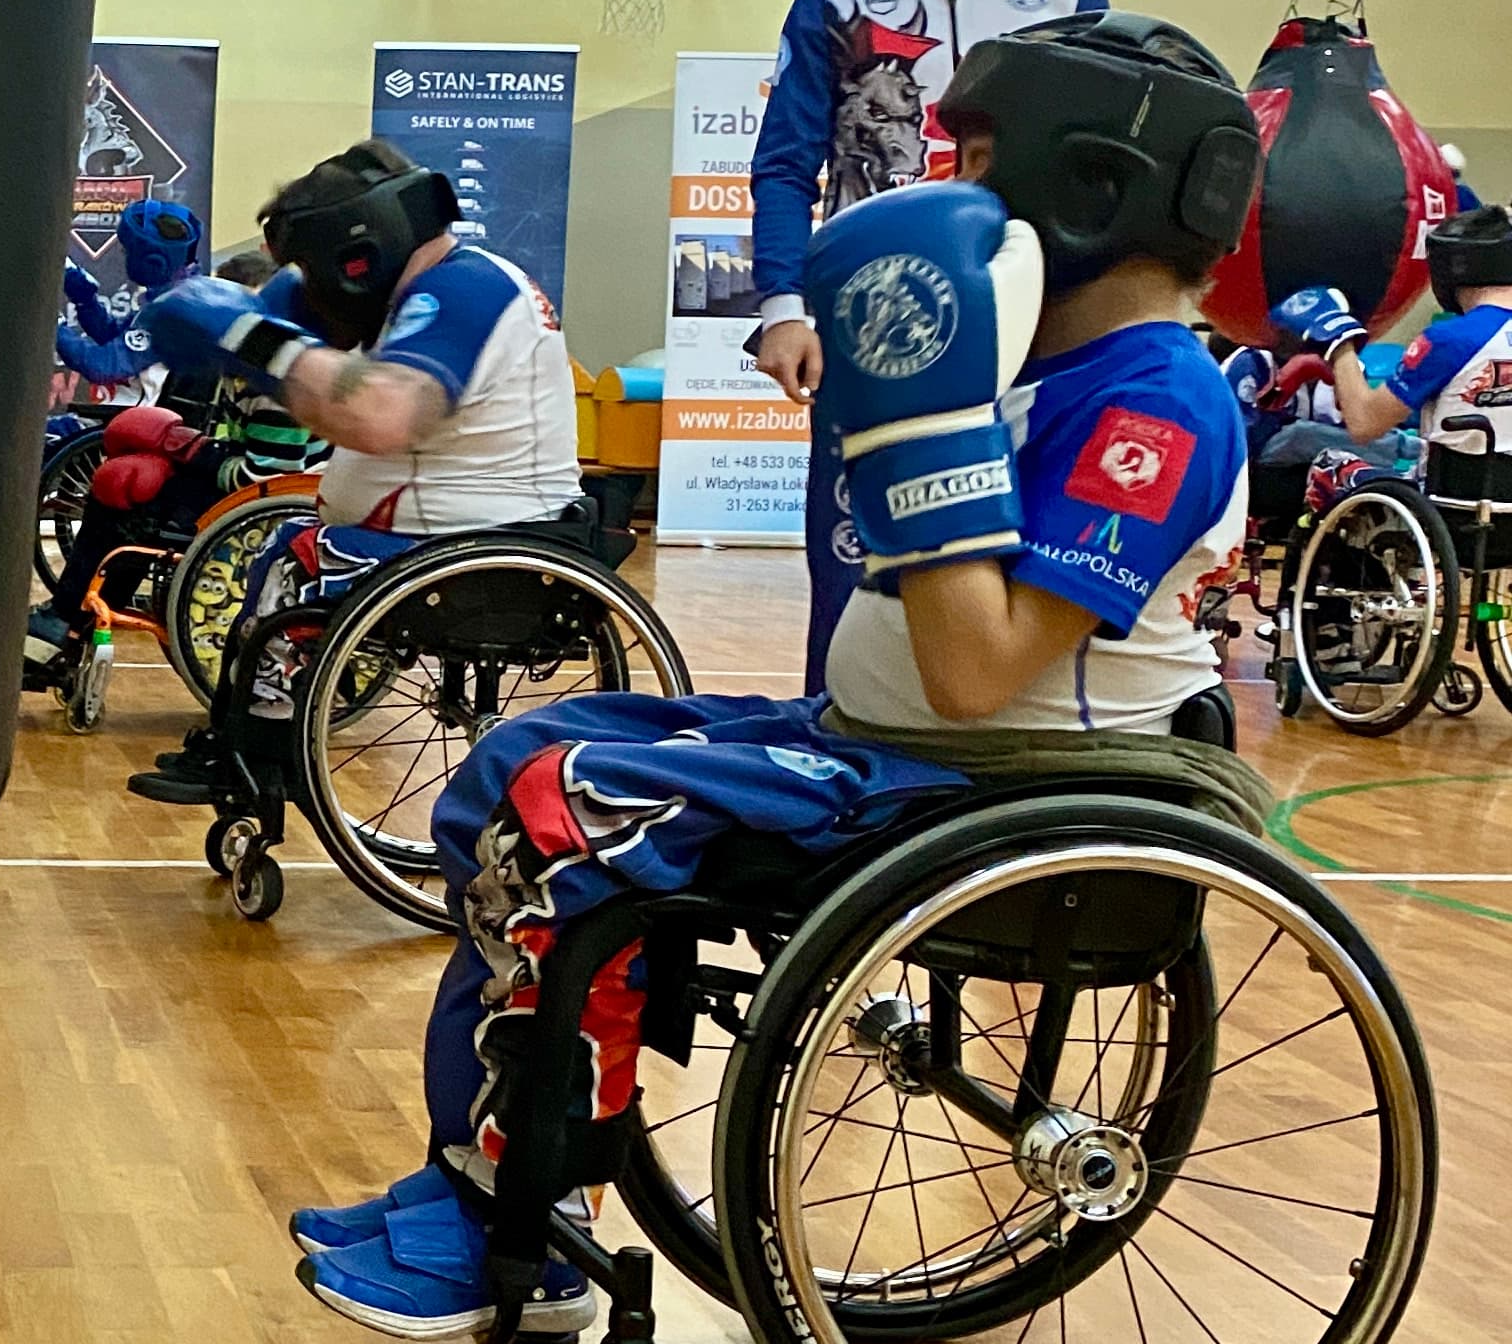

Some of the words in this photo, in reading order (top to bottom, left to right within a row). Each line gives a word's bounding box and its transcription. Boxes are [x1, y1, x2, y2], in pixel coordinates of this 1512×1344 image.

[418, 71, 566, 93] STAN-TRANS
[417, 92, 503, 100] INTERNATIONAL
[508, 93, 564, 101] LOGISTICS
[410, 115, 460, 129] SAFELY
[463, 117, 474, 129] &
[476, 117, 499, 129] ON
[501, 117, 536, 129] TIME
[678, 407, 810, 430] www.izabud
[711, 455, 730, 468] tel.
[734, 456, 758, 468] +48
[761, 456, 784, 469] 533
[705, 476, 778, 493] Władysława
[726, 499, 769, 512] 31-263
